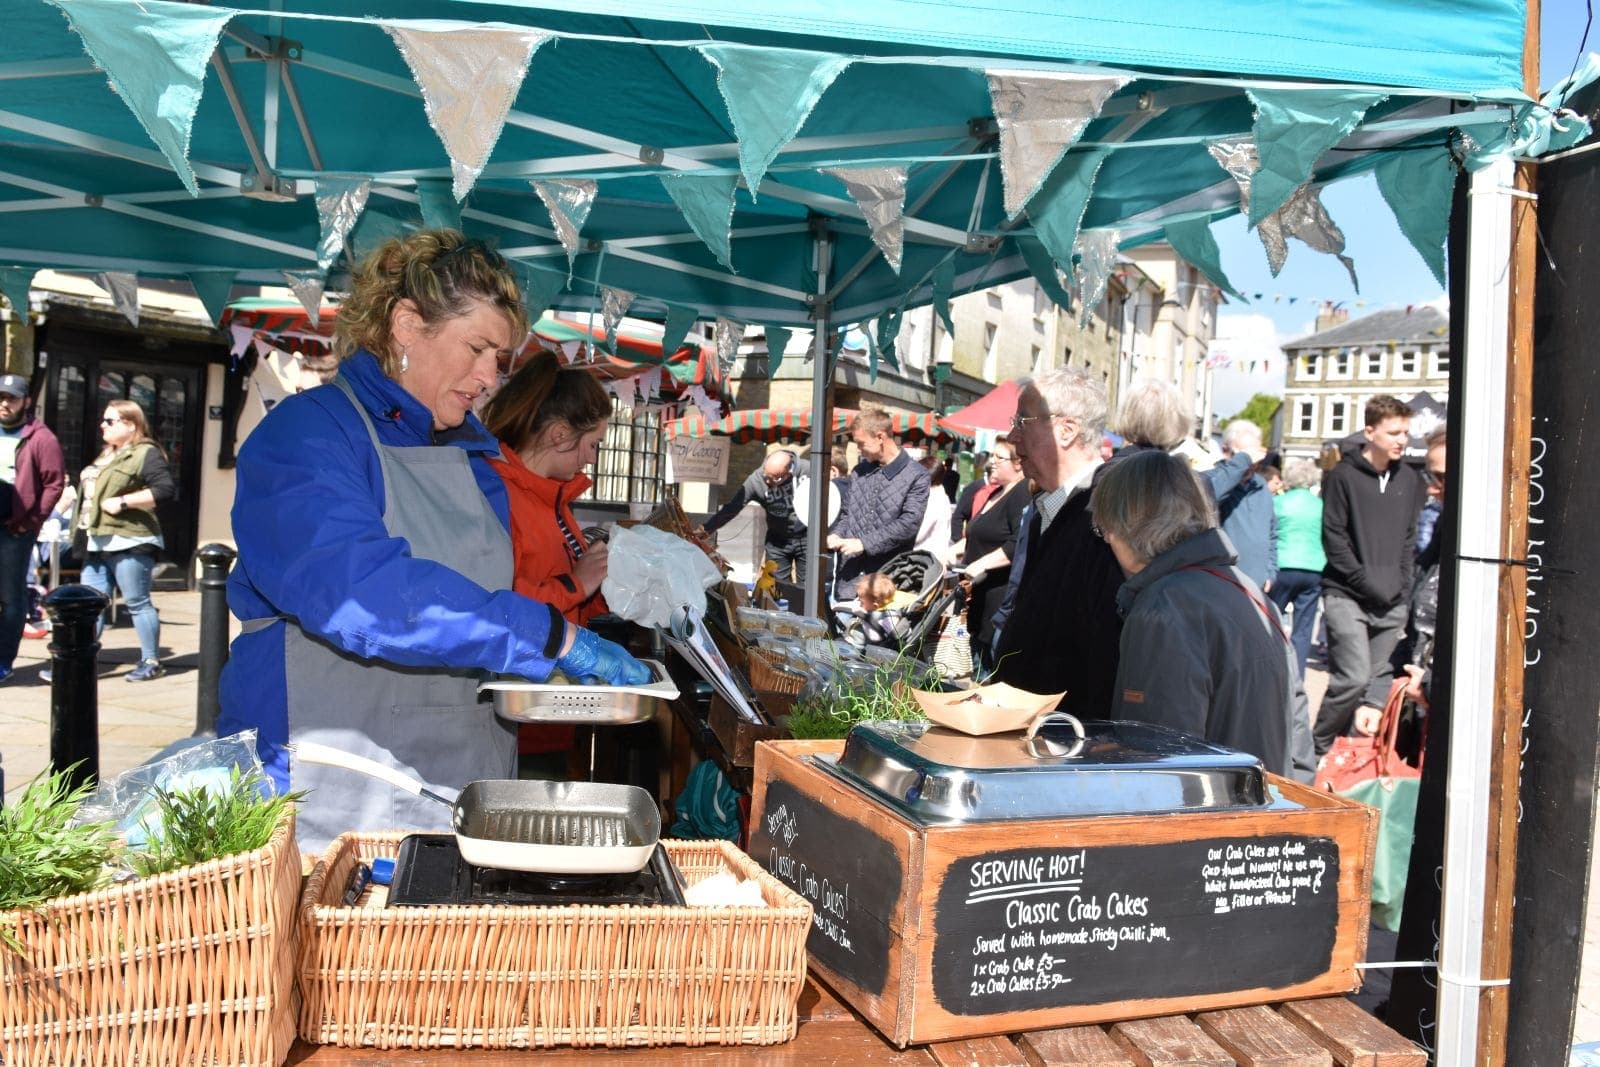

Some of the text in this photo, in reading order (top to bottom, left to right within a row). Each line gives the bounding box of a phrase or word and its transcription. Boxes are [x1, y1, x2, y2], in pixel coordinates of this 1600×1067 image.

[1226, 845, 1243, 860] Crab
[1245, 845, 1265, 860] Cakes
[1267, 846, 1280, 857] are
[1282, 841, 1306, 858] double
[970, 849, 1086, 888] SERVING HOT!
[1222, 861, 1245, 877] Award
[1295, 860, 1307, 871] use
[1309, 856, 1326, 875] only
[769, 846, 849, 924] Classic Crab Cakes!
[1229, 874, 1273, 890] handpicked
[1275, 872, 1290, 888] Crab
[1292, 875, 1311, 887] meat
[1006, 892, 1149, 929] Classic Crab Cakes
[1254, 895, 1264, 906] or
[973, 933, 1005, 955] Served
[1011, 926, 1035, 949] with
[1039, 927, 1088, 946] homemade
[1089, 926, 1118, 951] Sticky
[1119, 924, 1146, 941] Chilli
[988, 959, 1010, 976] Crab
[1013, 956, 1035, 973] Cake
[970, 981, 985, 996] 2x
[987, 977, 1008, 994] Crab
[1009, 976, 1034, 992] Cakes
